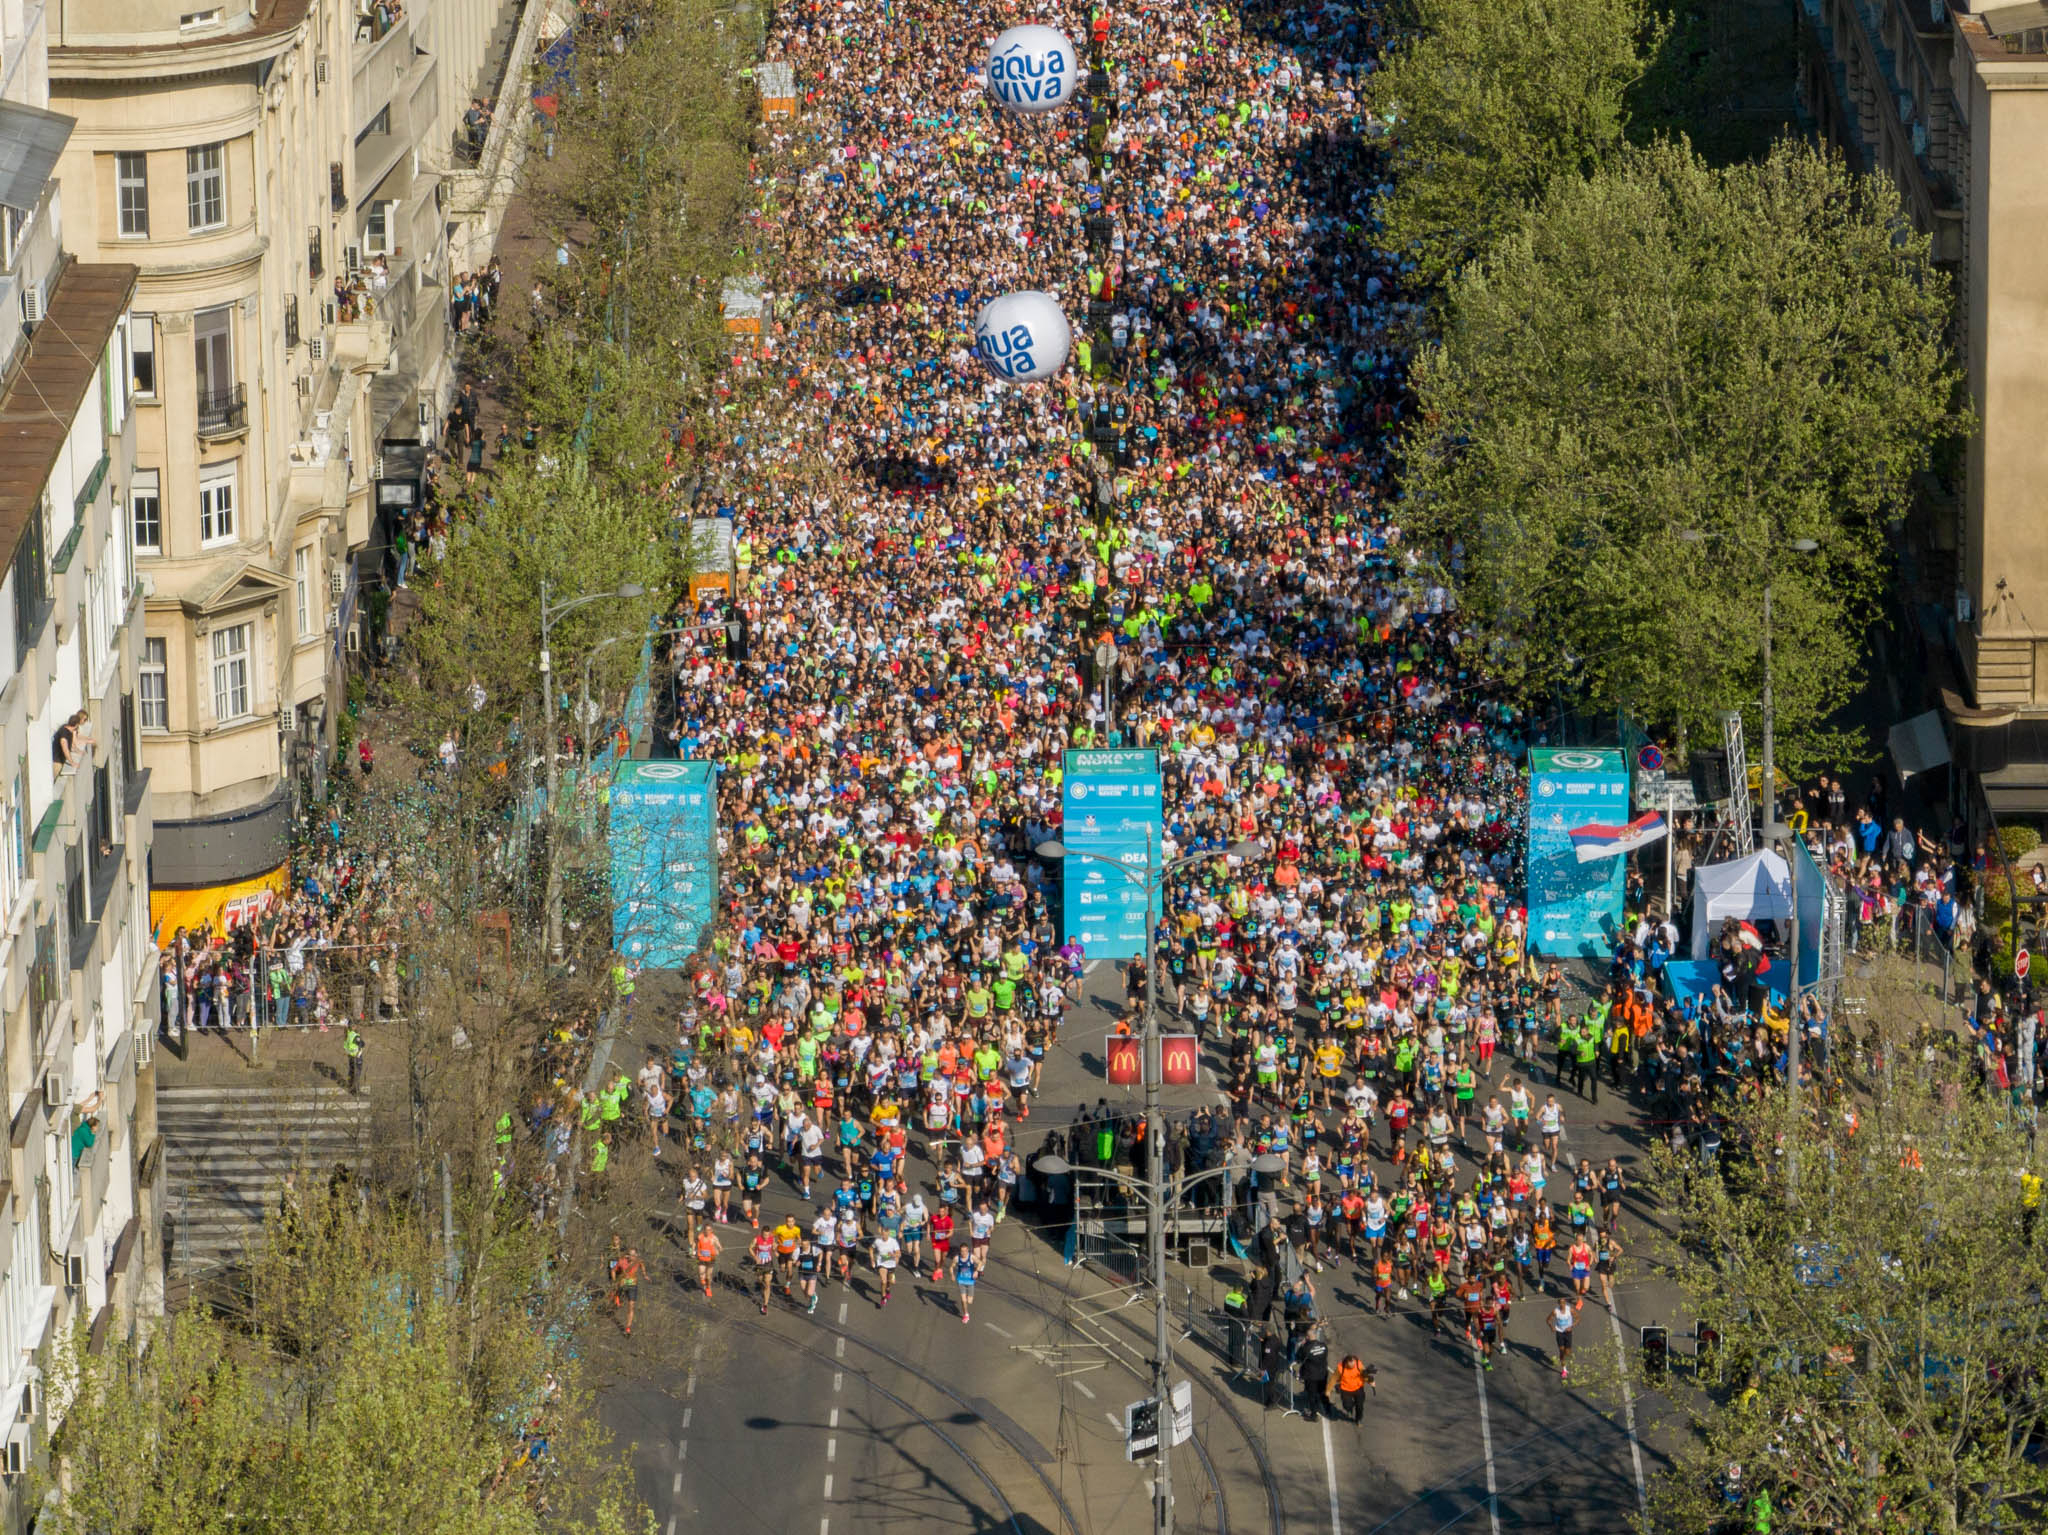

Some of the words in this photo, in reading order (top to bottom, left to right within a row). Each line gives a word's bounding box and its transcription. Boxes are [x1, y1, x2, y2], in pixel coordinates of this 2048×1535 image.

[994, 77, 1061, 102] viva
[1077, 753, 1144, 761] ALWAYS
[1077, 758, 1123, 766] MORE
[2017, 957, 2028, 969] STOP
